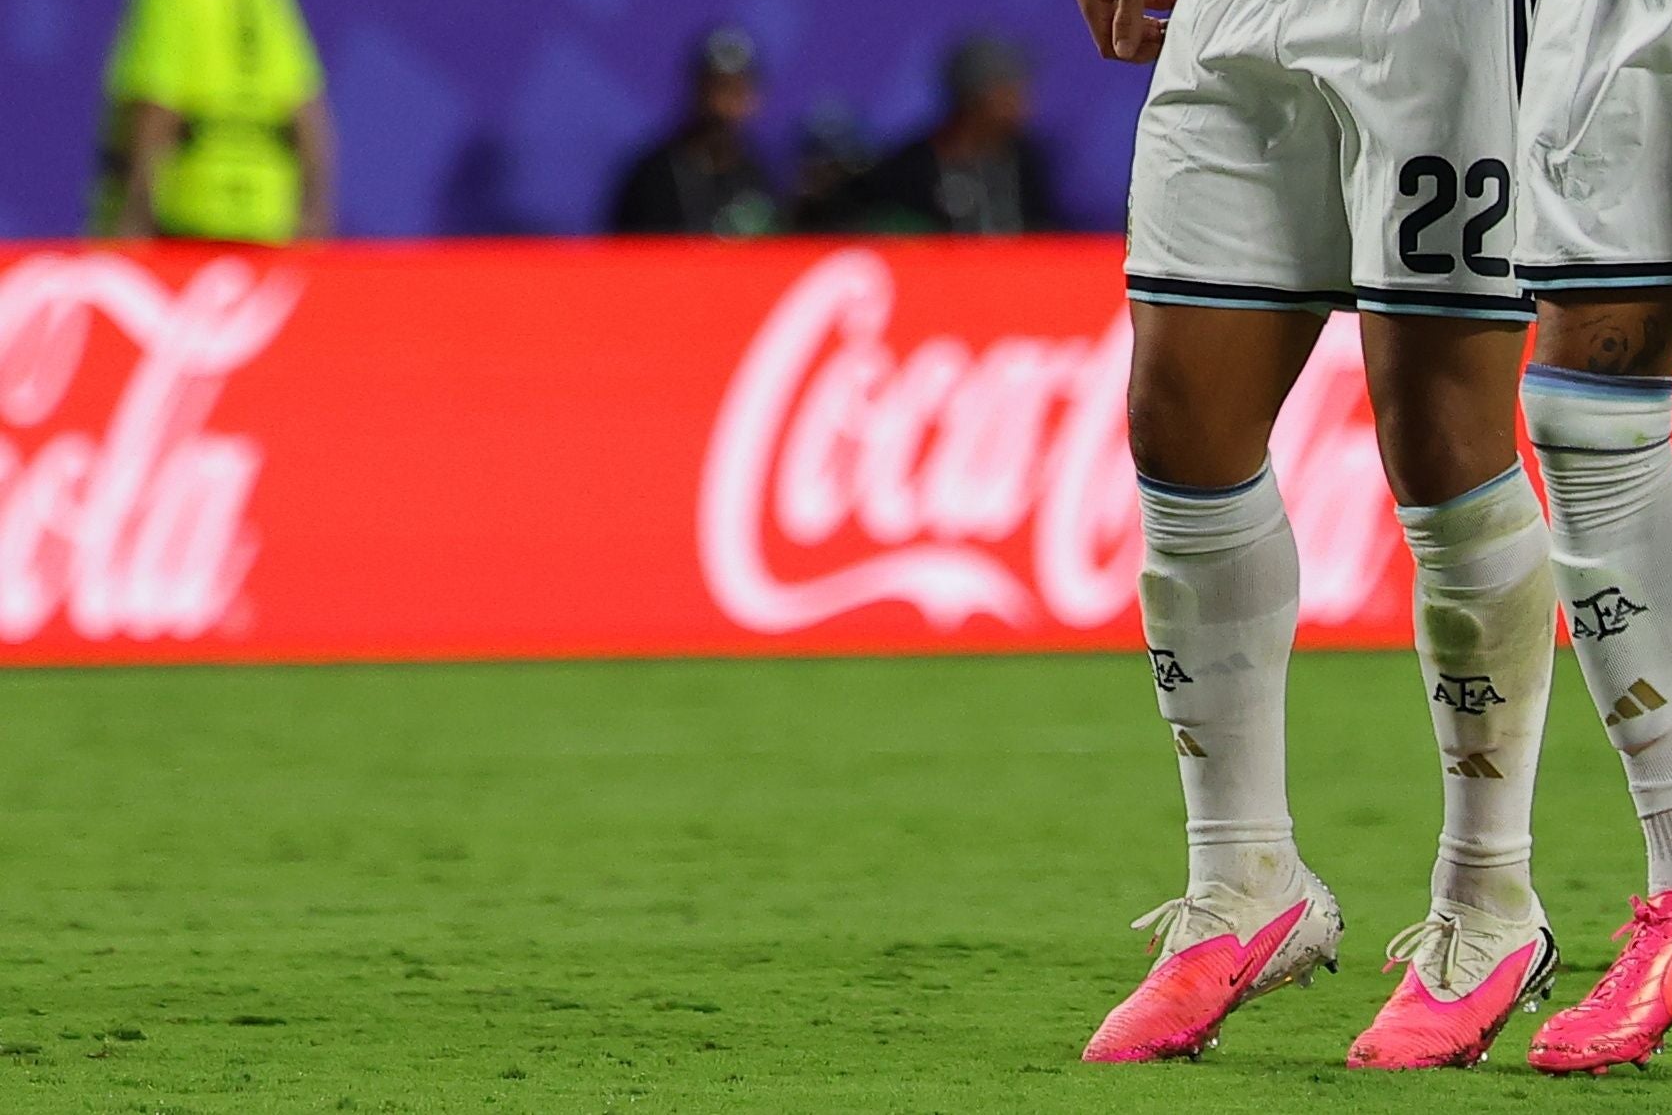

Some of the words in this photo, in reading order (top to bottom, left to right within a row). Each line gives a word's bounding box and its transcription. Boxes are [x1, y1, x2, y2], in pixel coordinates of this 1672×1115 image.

[1399, 155, 1511, 278] 22
[1573, 586, 1650, 642] AFA
[1148, 646, 1194, 692] FA
[1433, 673, 1507, 715] AFA
